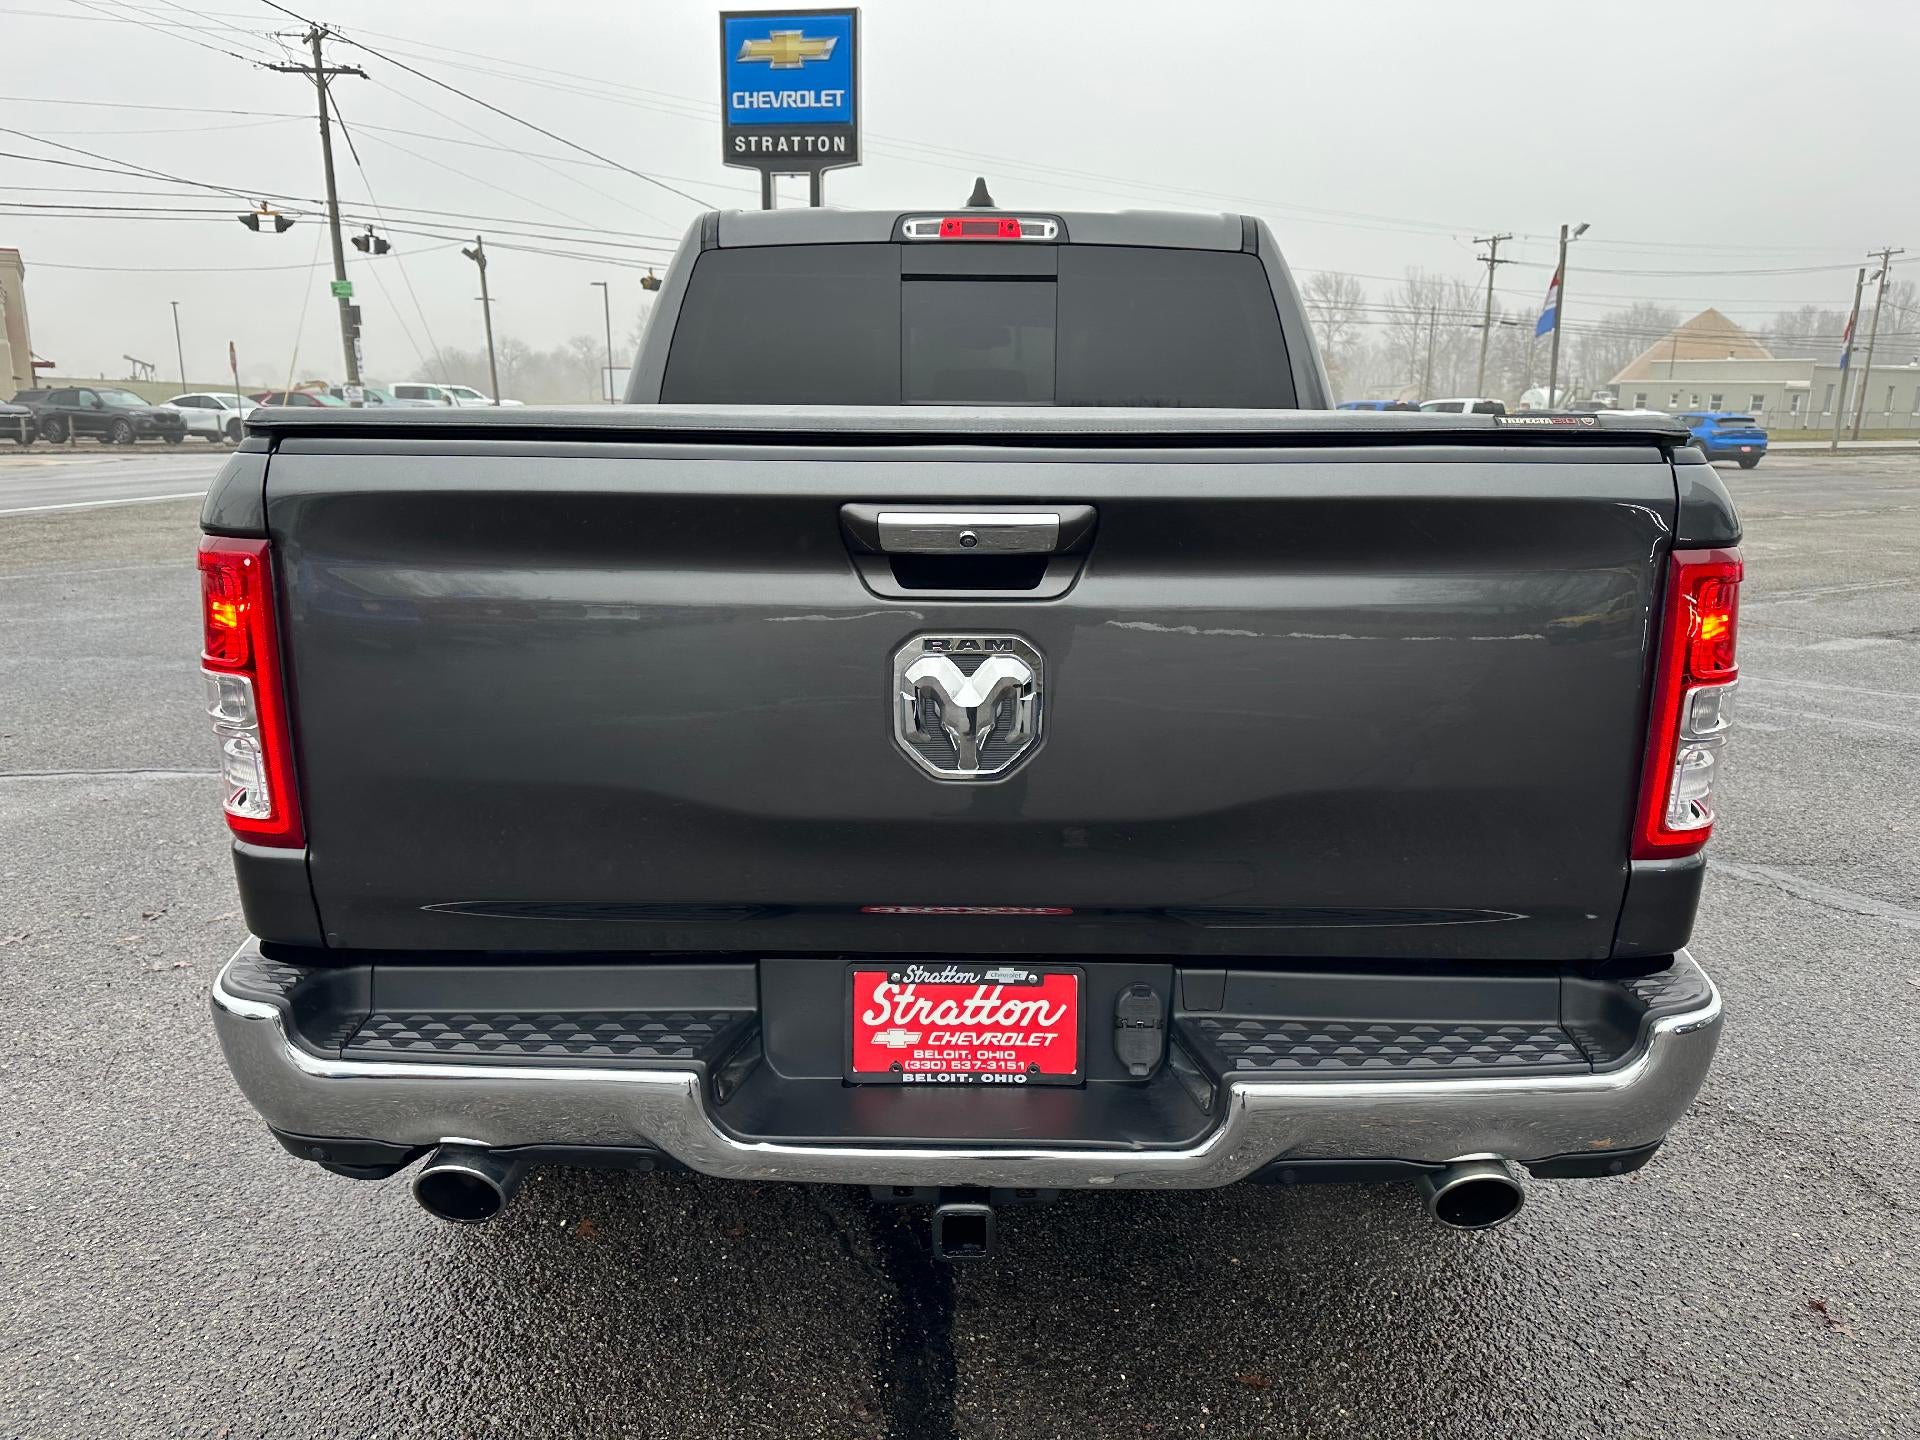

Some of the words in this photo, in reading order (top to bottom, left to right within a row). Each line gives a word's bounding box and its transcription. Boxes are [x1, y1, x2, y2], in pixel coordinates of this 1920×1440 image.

[732, 89, 845, 109] CHEVROLET
[734, 135, 846, 152] STRATTON
[923, 639, 1014, 652] RAM
[902, 964, 980, 984] Stratton
[862, 981, 1067, 1027] Stratton
[928, 1031, 1059, 1047] CHEVROLET
[913, 1050, 972, 1060] BELOIT,
[976, 1050, 1016, 1060] OHIO
[904, 1060, 947, 1070] (330)
[951, 1060, 1025, 1070] 537-3151
[902, 1073, 974, 1083] BELOIT,
[980, 1073, 1028, 1083] OHIO
